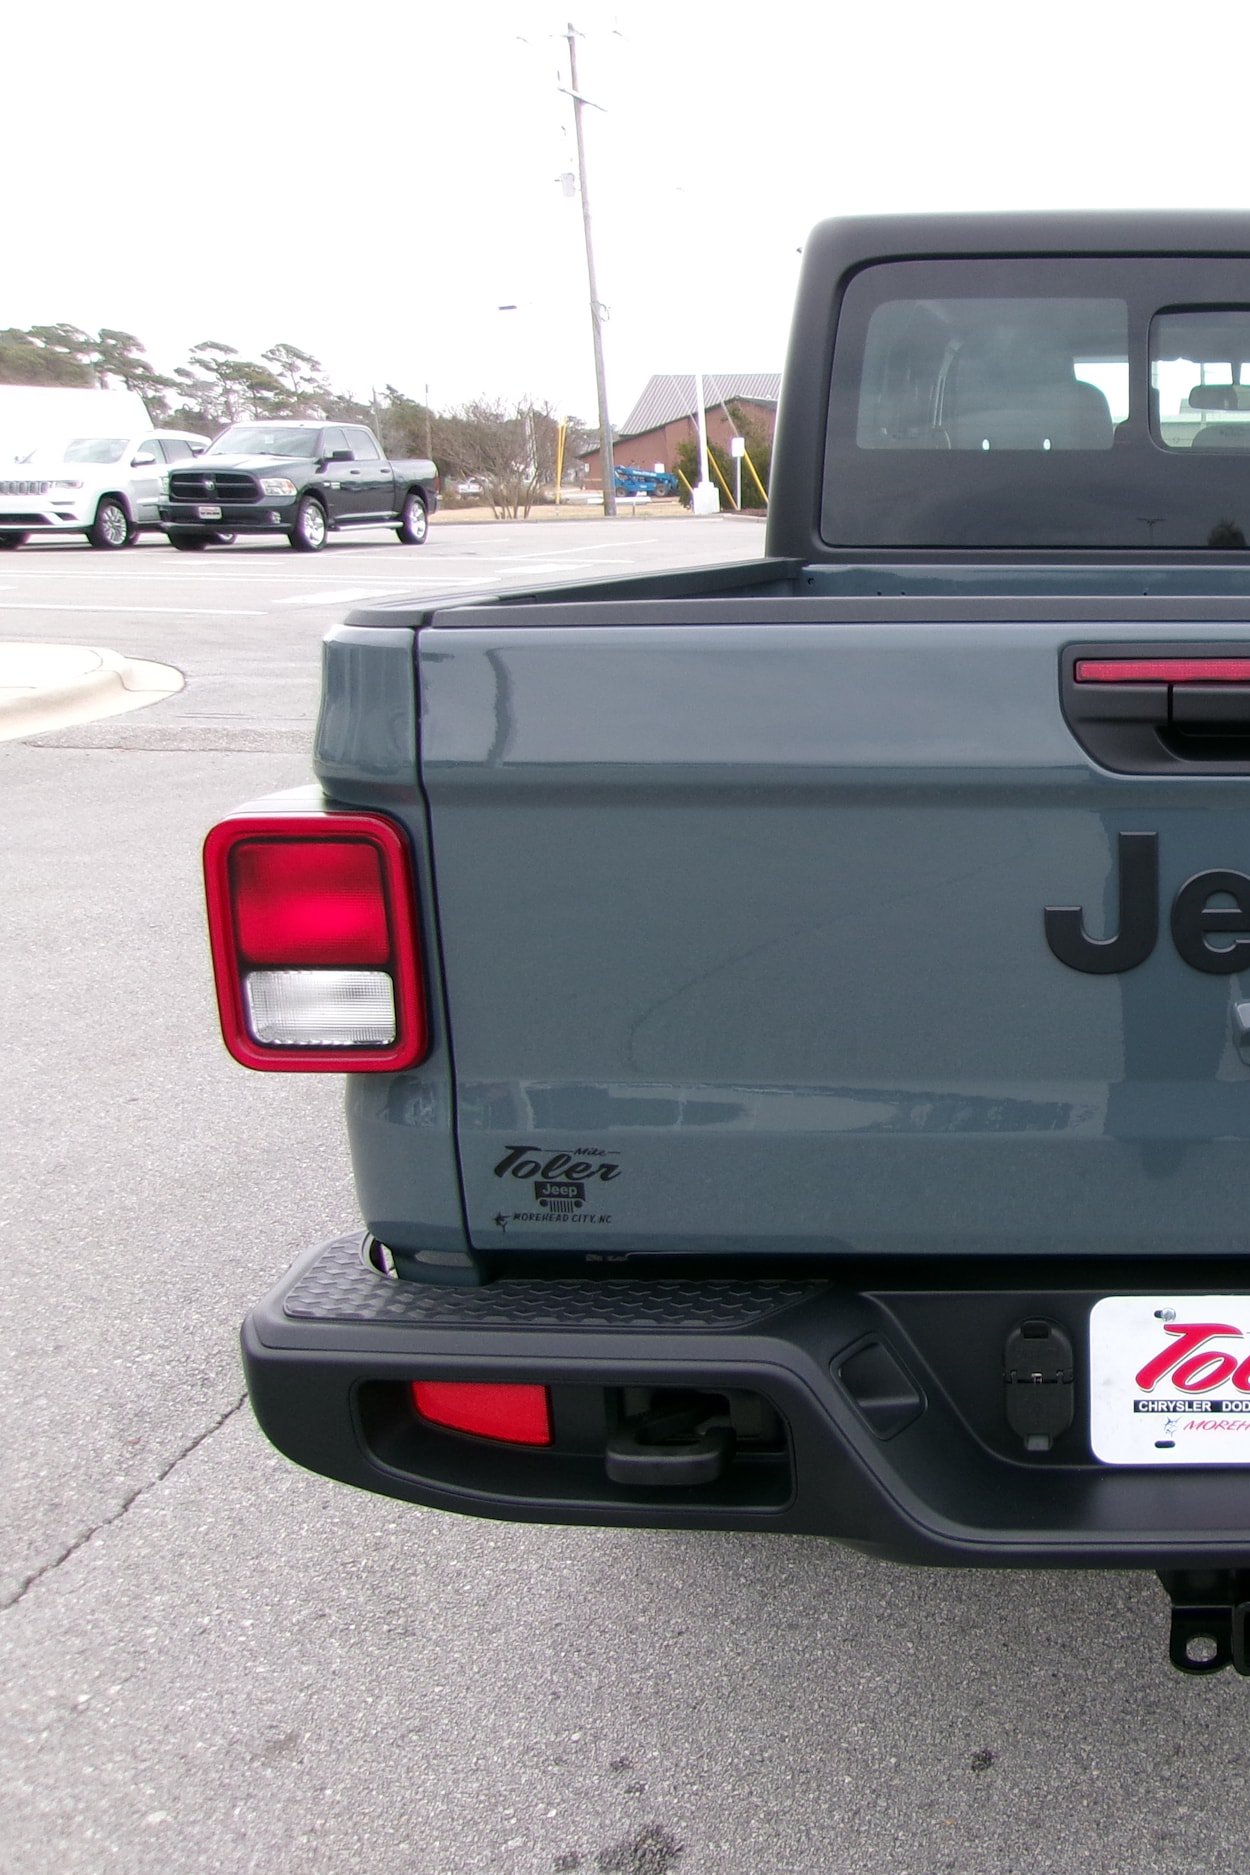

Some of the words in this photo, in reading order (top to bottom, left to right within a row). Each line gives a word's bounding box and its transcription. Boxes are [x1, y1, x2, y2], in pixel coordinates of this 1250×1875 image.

[574, 1147, 607, 1157] Mike
[494, 1145, 622, 1181] Toler
[542, 1184, 577, 1198] Jeep
[513, 1213, 569, 1223] MOREHEAD
[599, 1215, 612, 1224] NC
[1138, 1401, 1212, 1412] CHRYSLER
